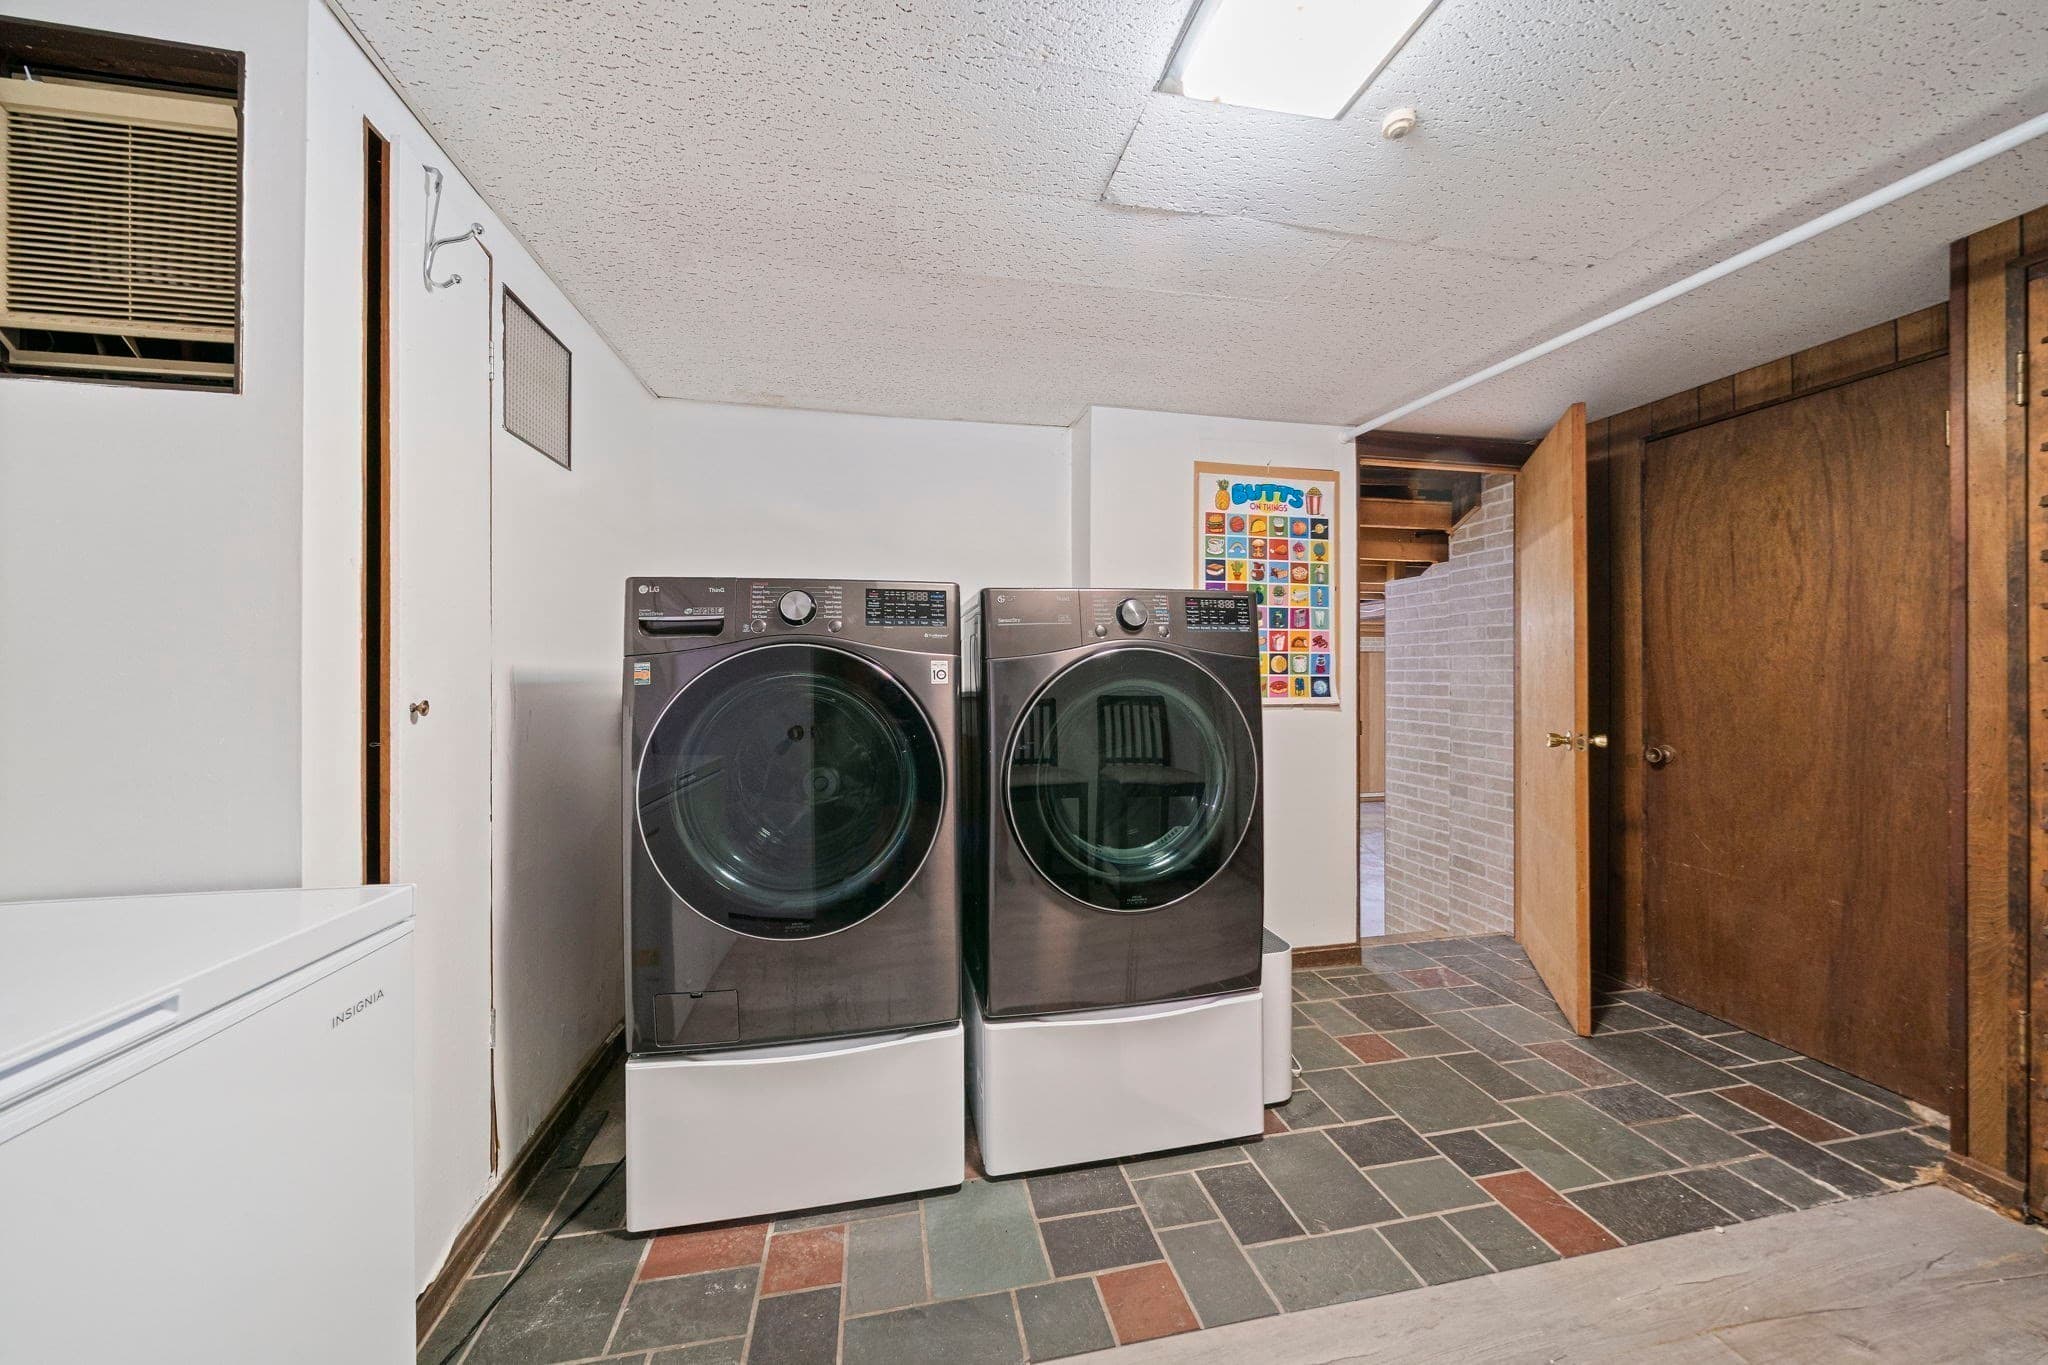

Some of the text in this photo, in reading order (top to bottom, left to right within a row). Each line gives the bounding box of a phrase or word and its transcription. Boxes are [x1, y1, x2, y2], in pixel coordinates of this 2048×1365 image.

[1231, 483, 1304, 509] BUTTS
[1249, 502, 1288, 512] ON THINGS
[331, 989, 385, 1029] INSIGNIA
